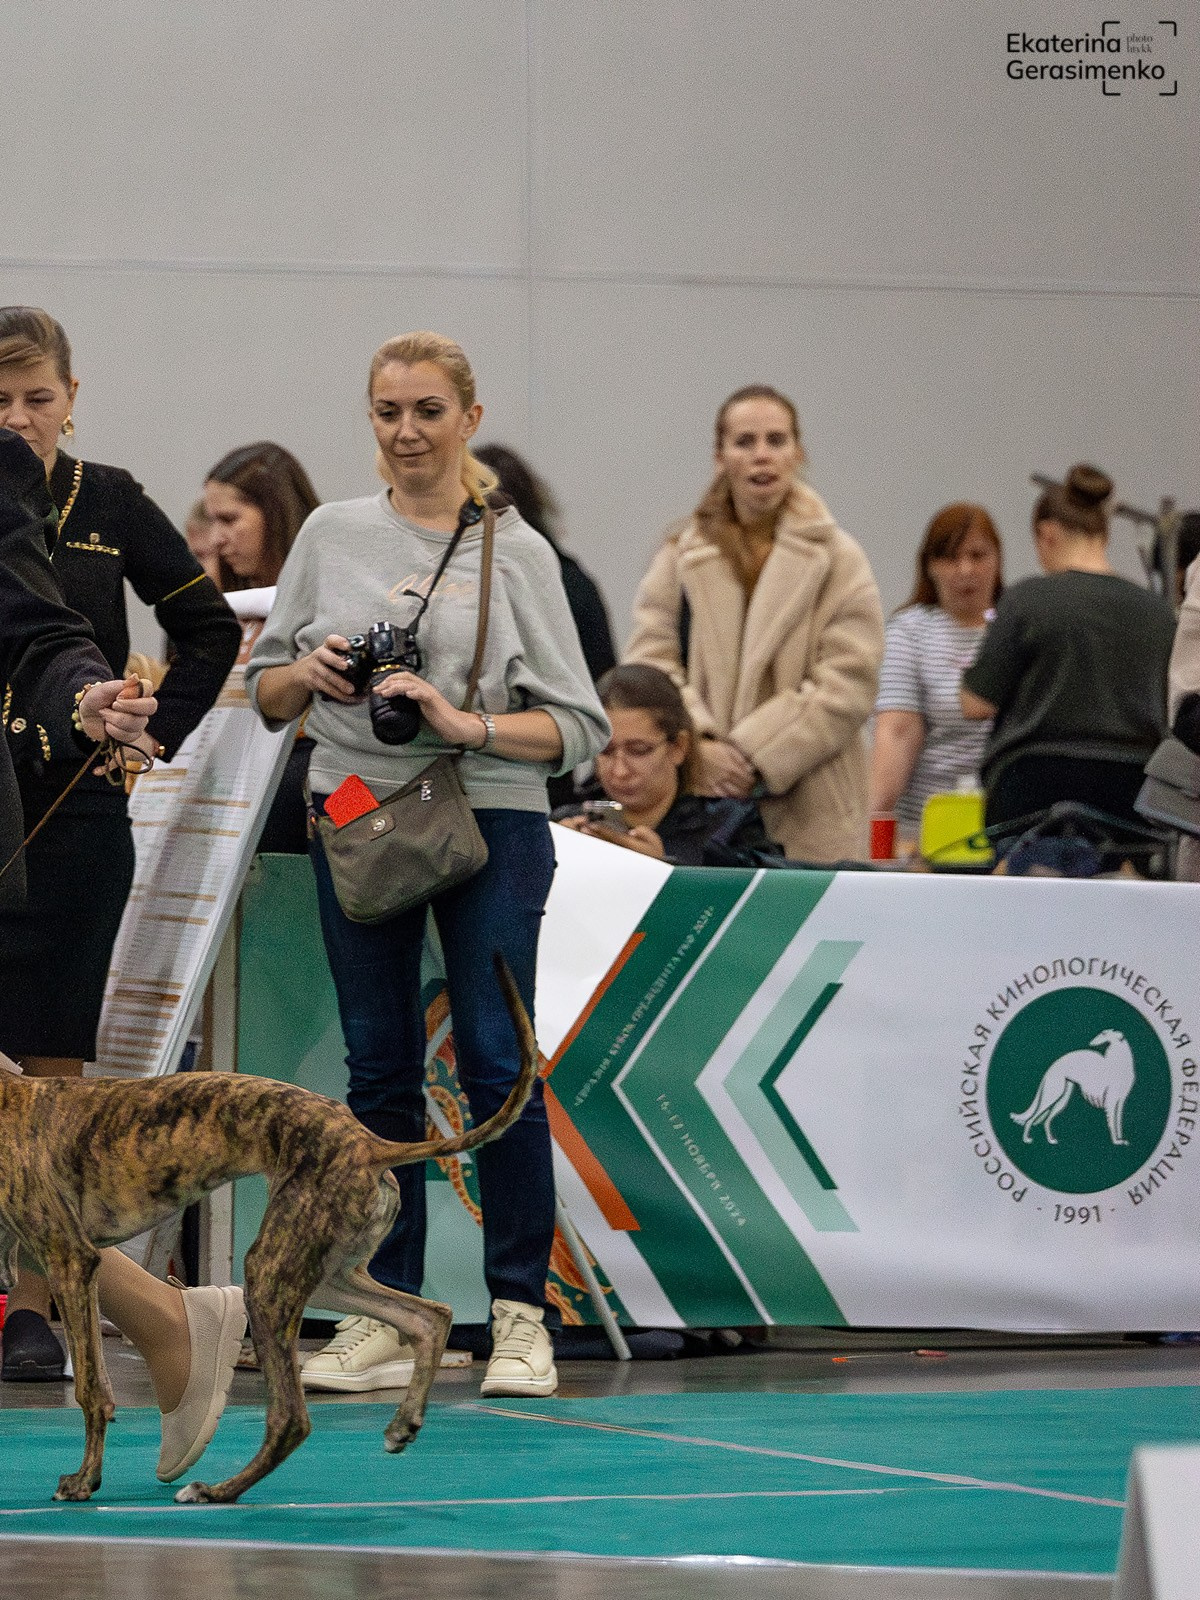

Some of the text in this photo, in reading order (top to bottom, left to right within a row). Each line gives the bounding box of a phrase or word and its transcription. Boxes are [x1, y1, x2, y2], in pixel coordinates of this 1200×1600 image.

[959, 956, 1199, 1205] РОССИЙСКАЯ КИНОЛОГИЧЕСКАЯ ФЕДЕРАЦИЯ
[1054, 1204, 1101, 1224] 1991
